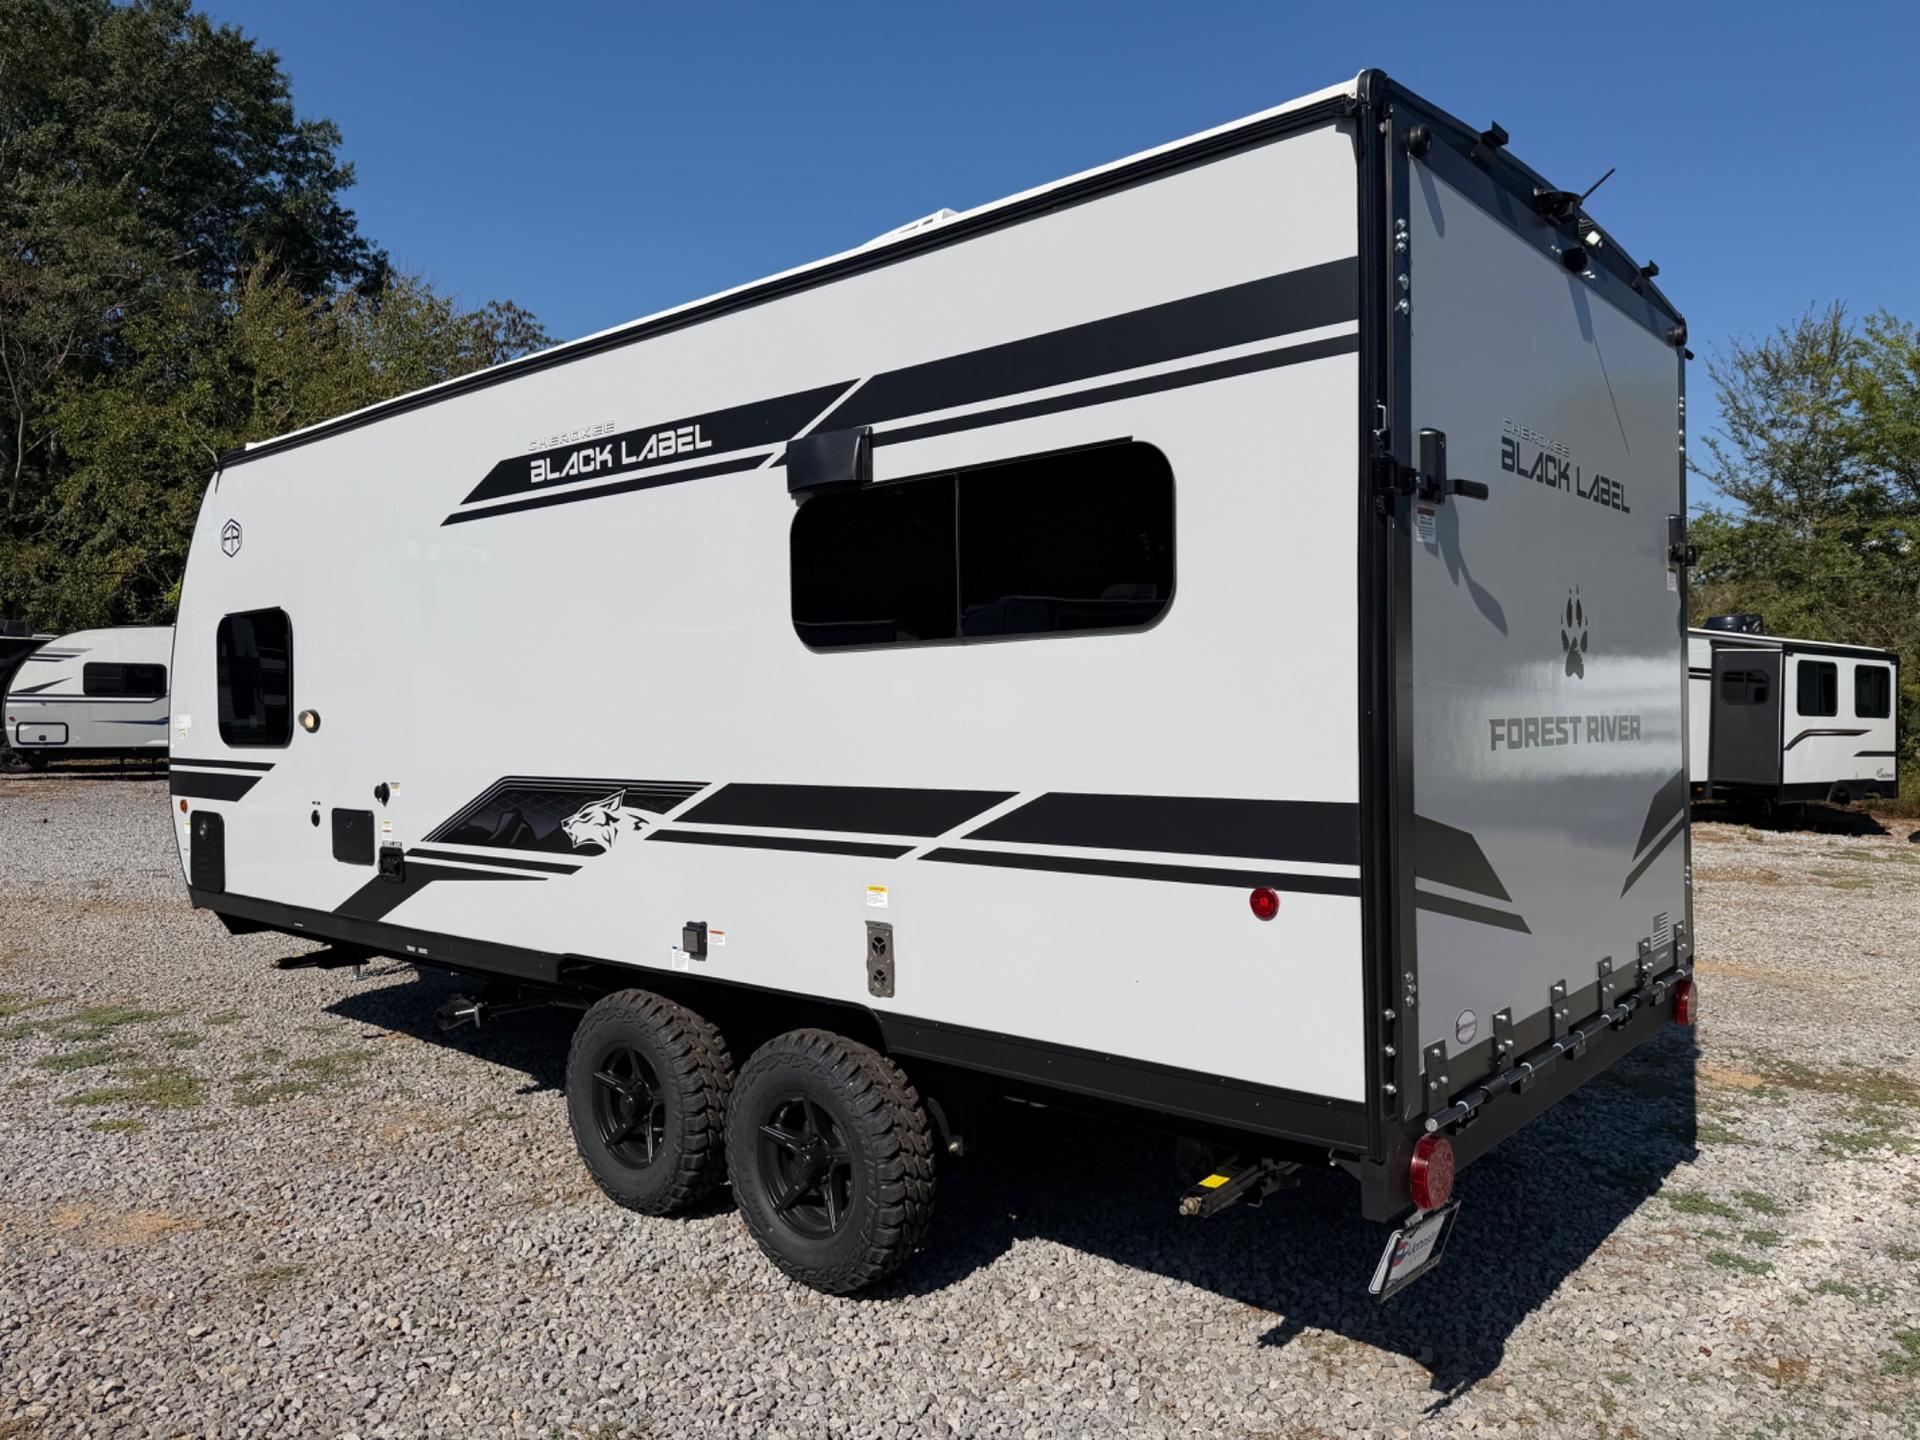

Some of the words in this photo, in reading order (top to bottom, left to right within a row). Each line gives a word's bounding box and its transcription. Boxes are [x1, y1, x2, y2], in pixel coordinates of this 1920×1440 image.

[528, 421, 615, 451] CHEROKEE
[530, 444, 613, 484] BLACK
[621, 424, 712, 465] LABEL
[1501, 436, 1571, 493] BLACK
[1577, 466, 1631, 514] LABEL
[1488, 716, 1582, 751] FOREST
[1586, 715, 1641, 743] RIVER
